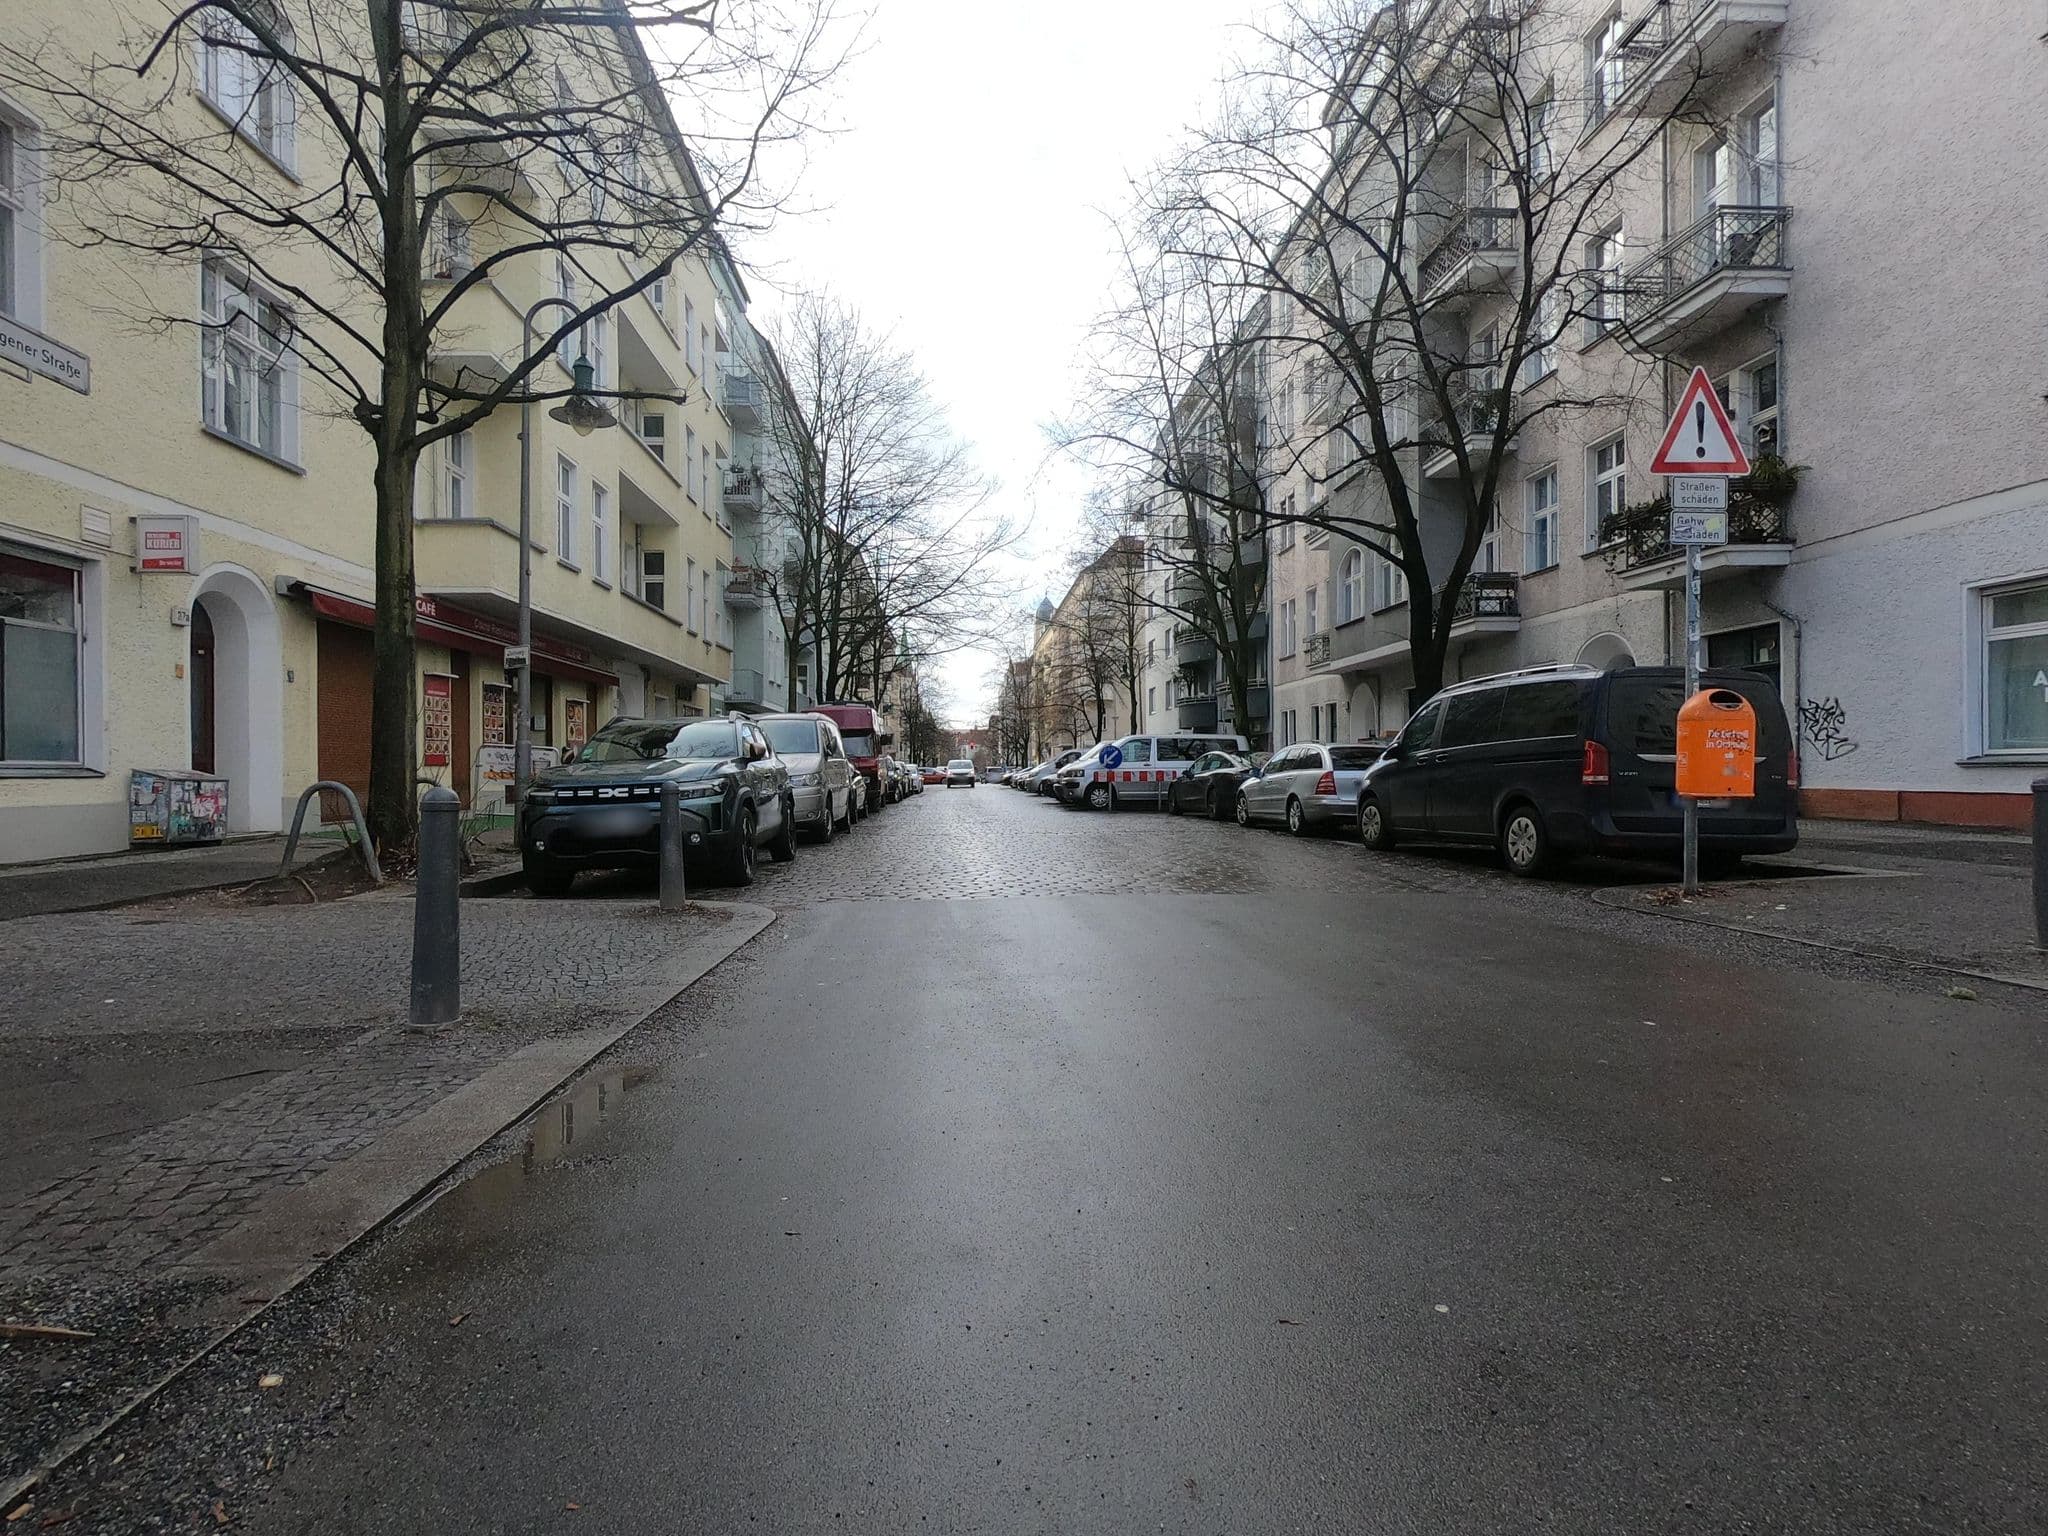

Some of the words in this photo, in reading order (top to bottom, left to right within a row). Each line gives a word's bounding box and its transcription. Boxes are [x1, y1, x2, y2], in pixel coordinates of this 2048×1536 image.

[41, 349, 81, 378] Straße
[1680, 482, 1720, 491] Straßen-
[1681, 495, 1719, 504] schäden
[1677, 516, 1721, 526] Gehw
[415, 600, 436, 616] CAFÉ
